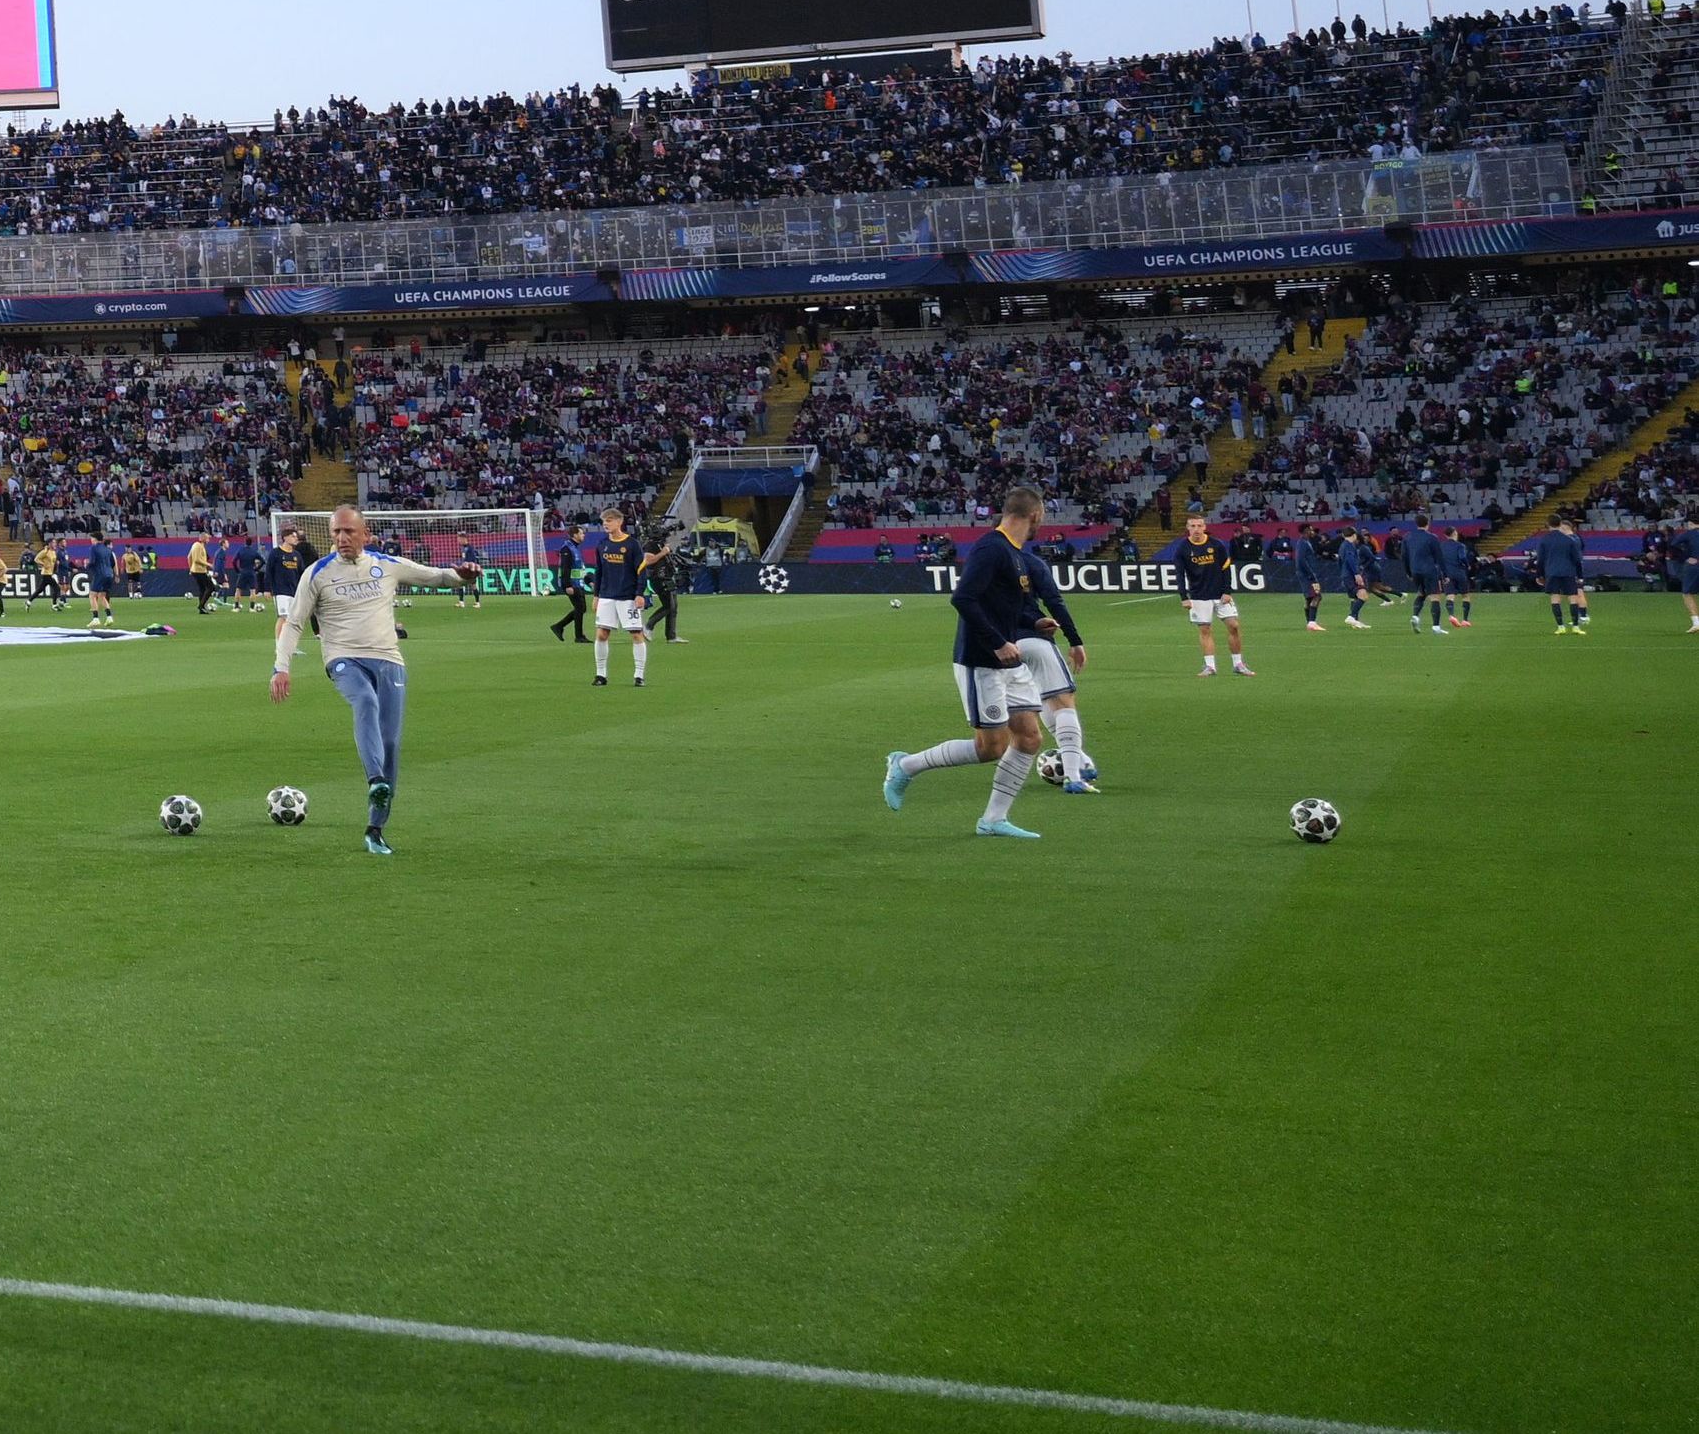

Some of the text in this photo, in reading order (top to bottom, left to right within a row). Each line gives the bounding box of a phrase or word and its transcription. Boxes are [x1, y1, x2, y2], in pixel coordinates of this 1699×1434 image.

[1143, 243, 1354, 267] UEFA CHAMPIONS LEAGUE
[394, 285, 571, 303] UEFA CHAMPIONS LEAGUE
[108, 302, 167, 313] crypto.com
[335, 580, 382, 596] QATAR
[476, 568, 556, 592] EVER
